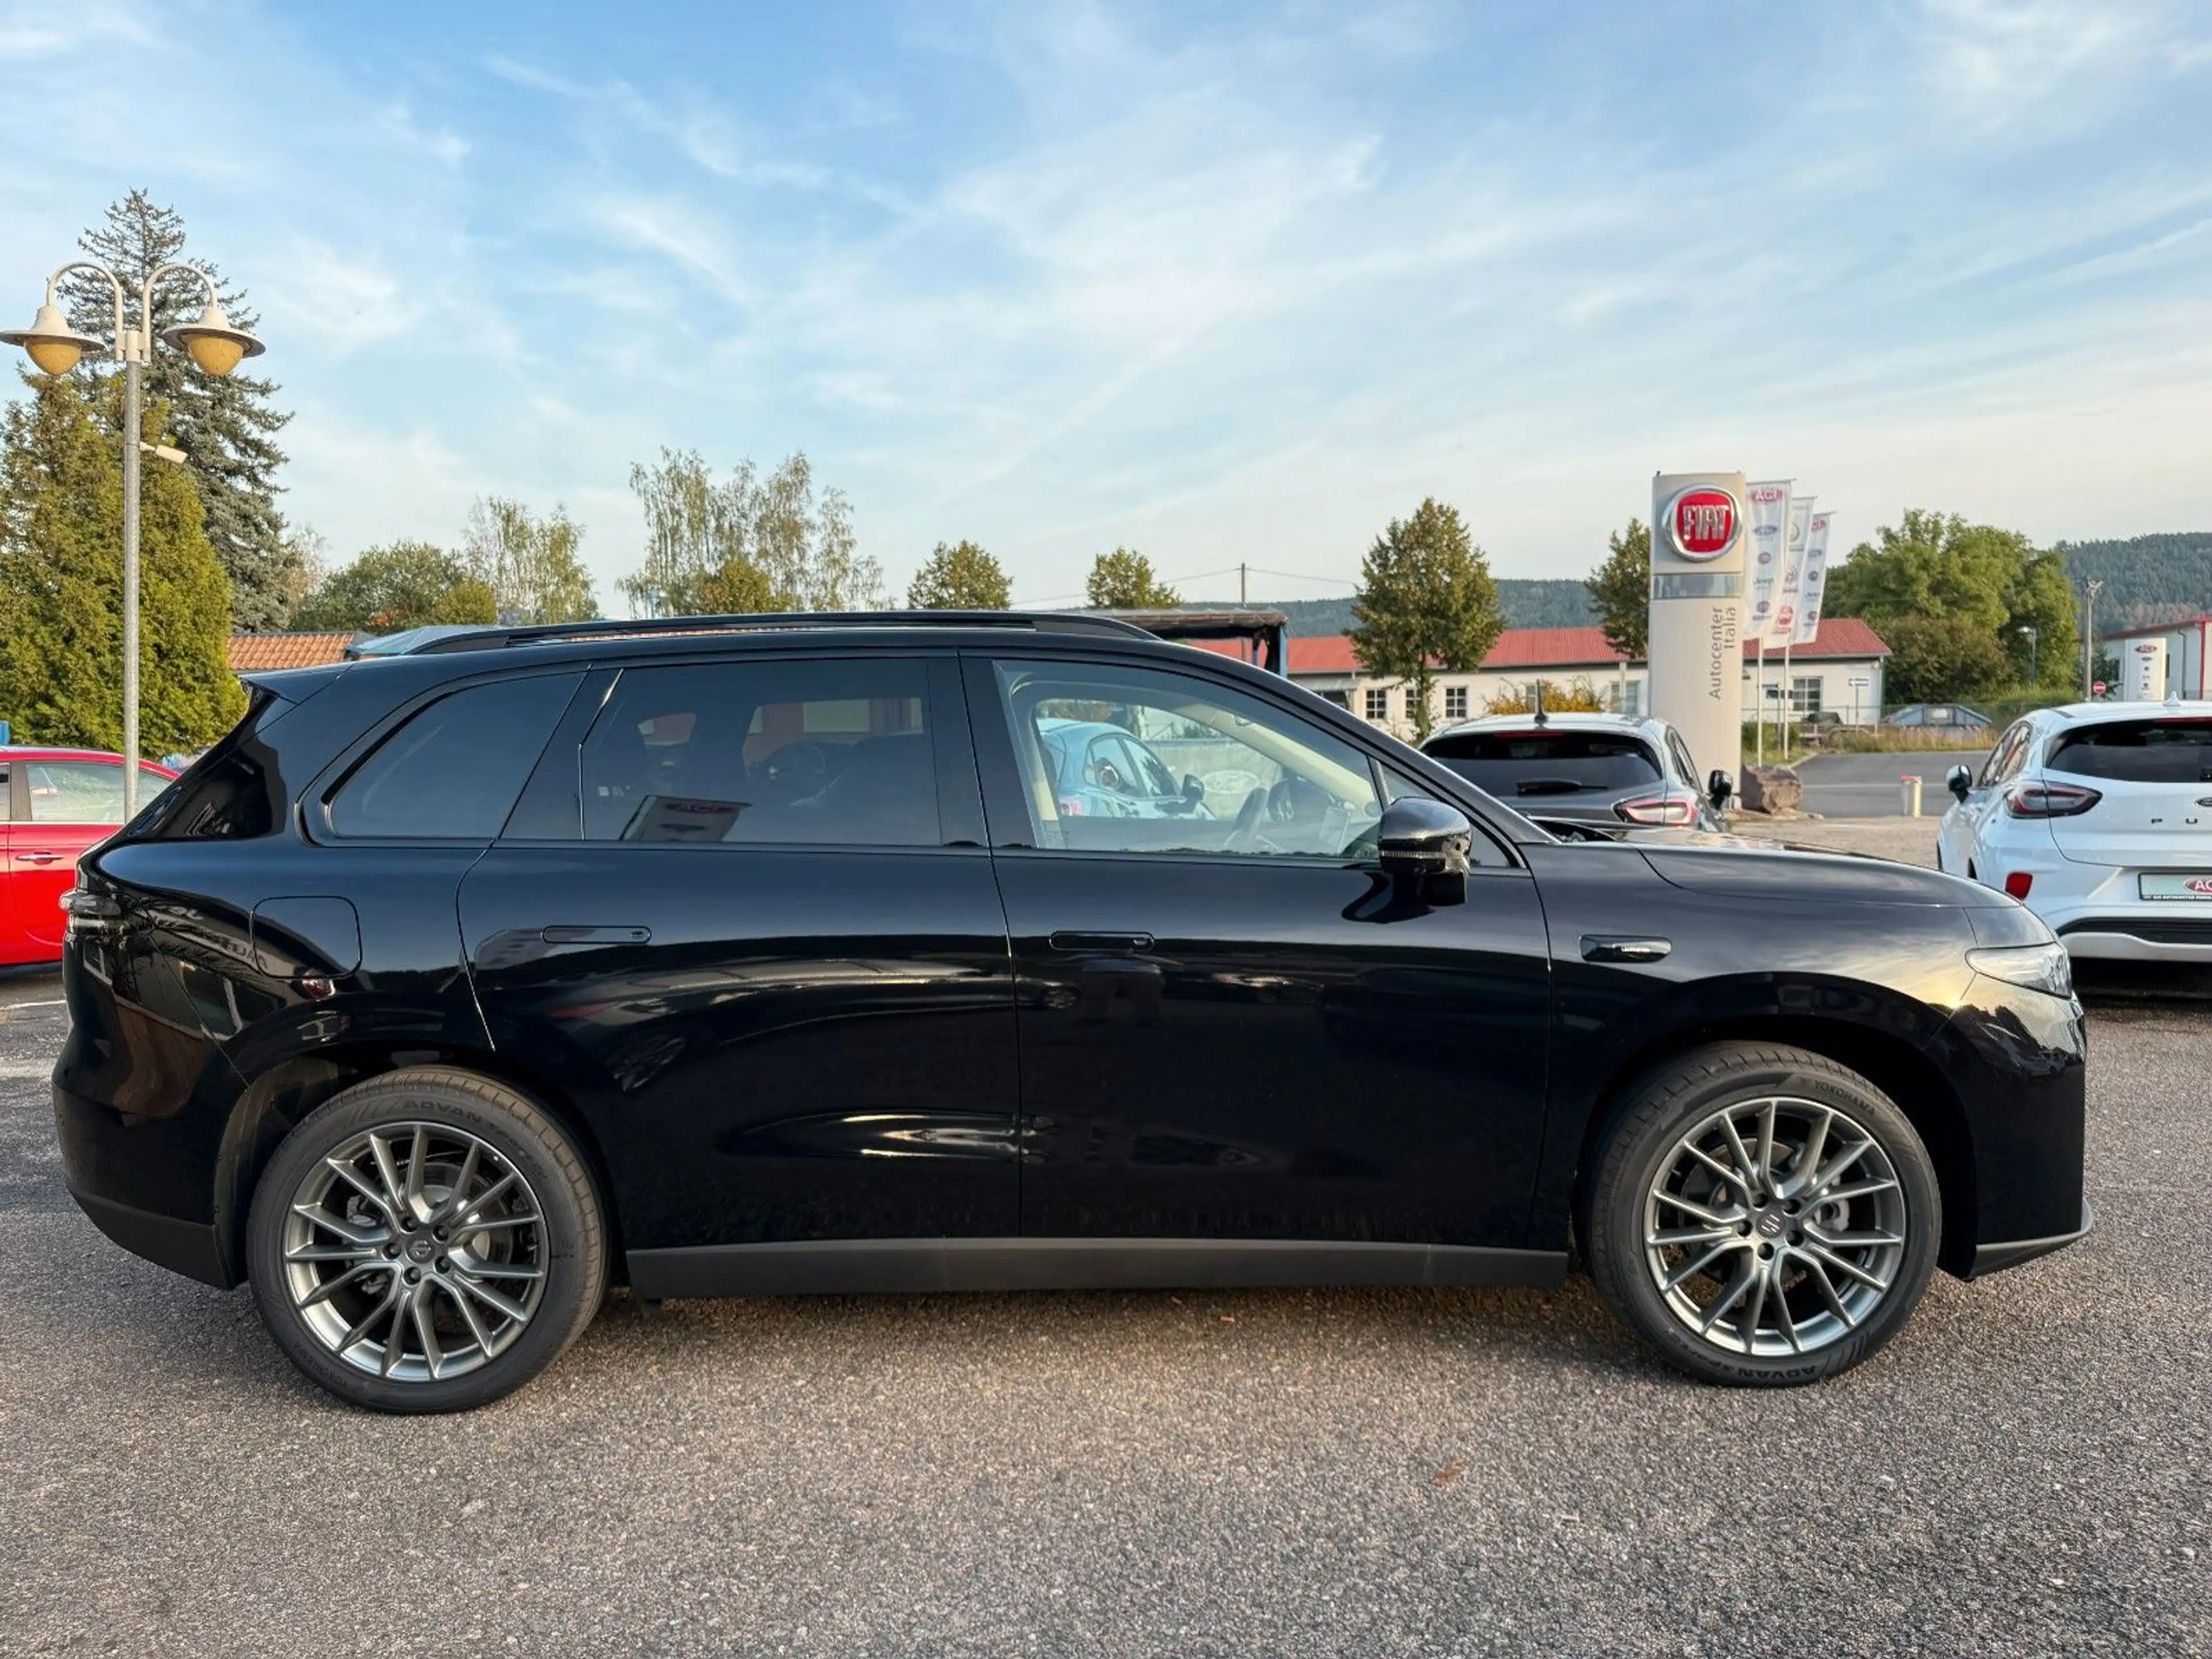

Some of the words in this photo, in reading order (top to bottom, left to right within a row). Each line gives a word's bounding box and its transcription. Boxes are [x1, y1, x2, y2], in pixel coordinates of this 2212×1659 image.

[1682, 504, 1730, 541] FIAT
[1723, 607, 1736, 649] Italia
[1709, 607, 1722, 700] Autocenter
[404, 1100, 482, 1123] ADVAN
[1815, 1080, 1875, 1115] YOKOHAMA
[1738, 1365, 1816, 1379] ADVAN
